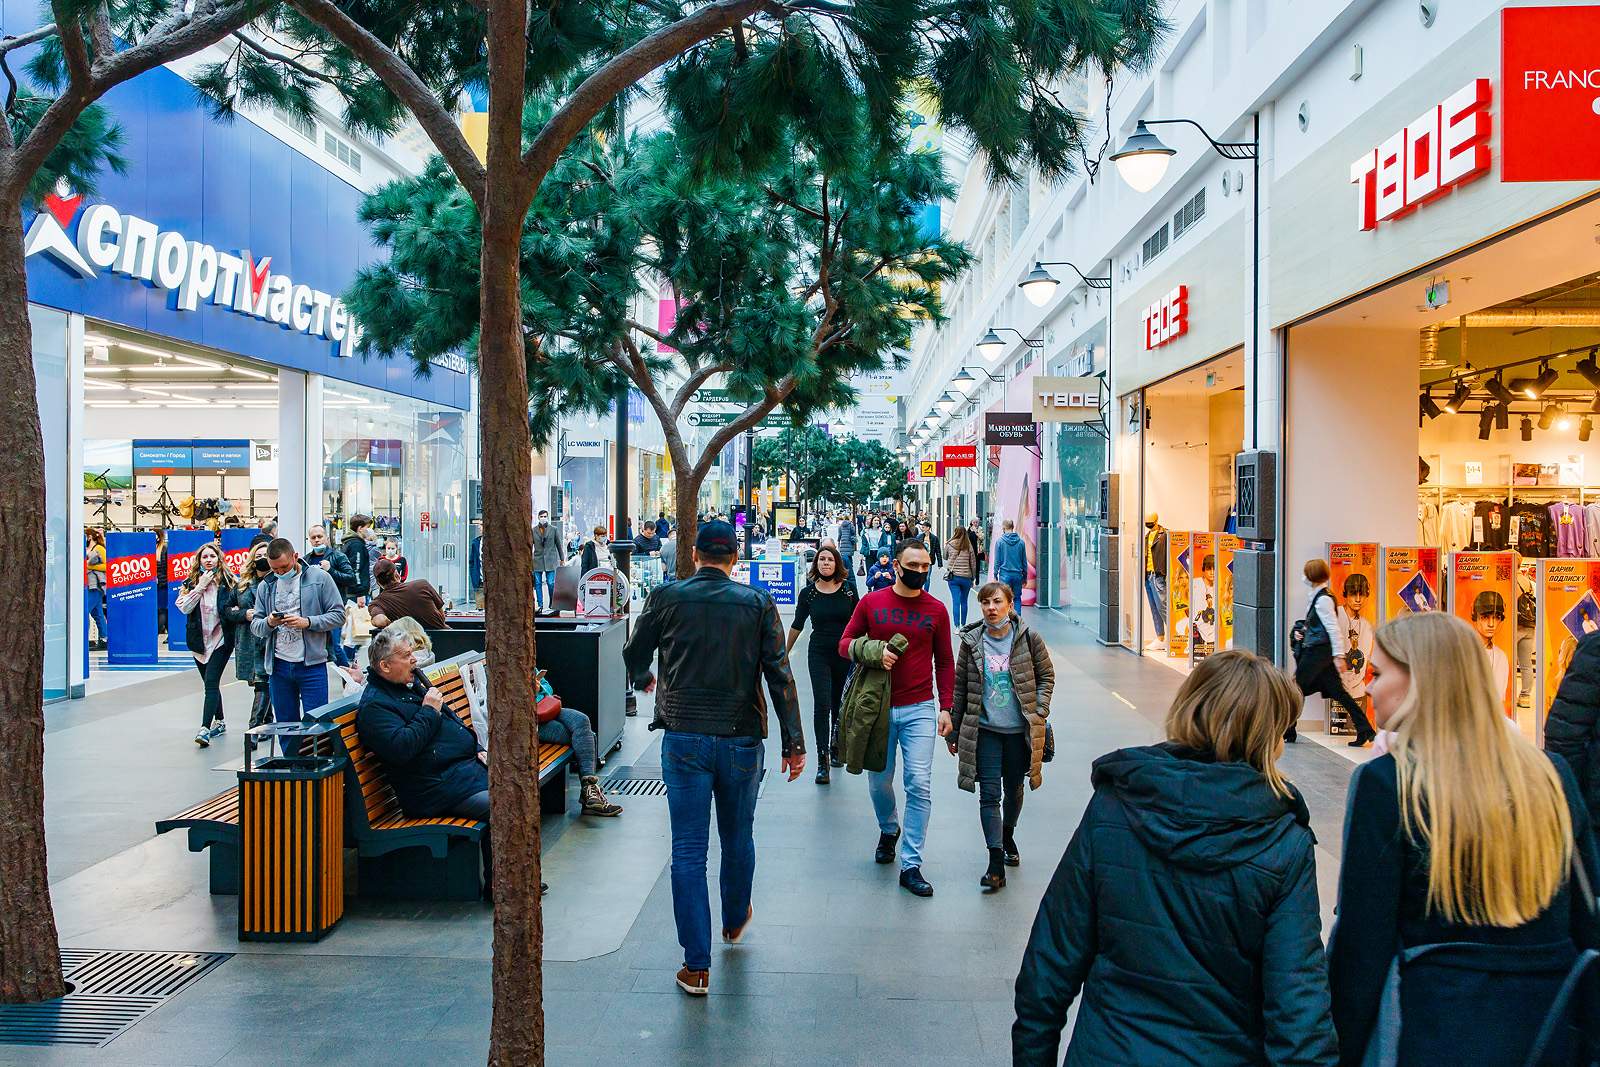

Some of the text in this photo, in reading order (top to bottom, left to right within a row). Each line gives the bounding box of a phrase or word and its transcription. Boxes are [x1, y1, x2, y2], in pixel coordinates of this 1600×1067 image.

[1350, 78, 1492, 231] ТВОЕ
[1141, 285, 1189, 350] ТВОЕ
[1038, 391, 1101, 408] ТВОЕ
[988, 424, 1035, 432] MARIO MIKKE
[110, 557, 151, 577] 2000
[112, 570, 152, 584] БОНУСОВ
